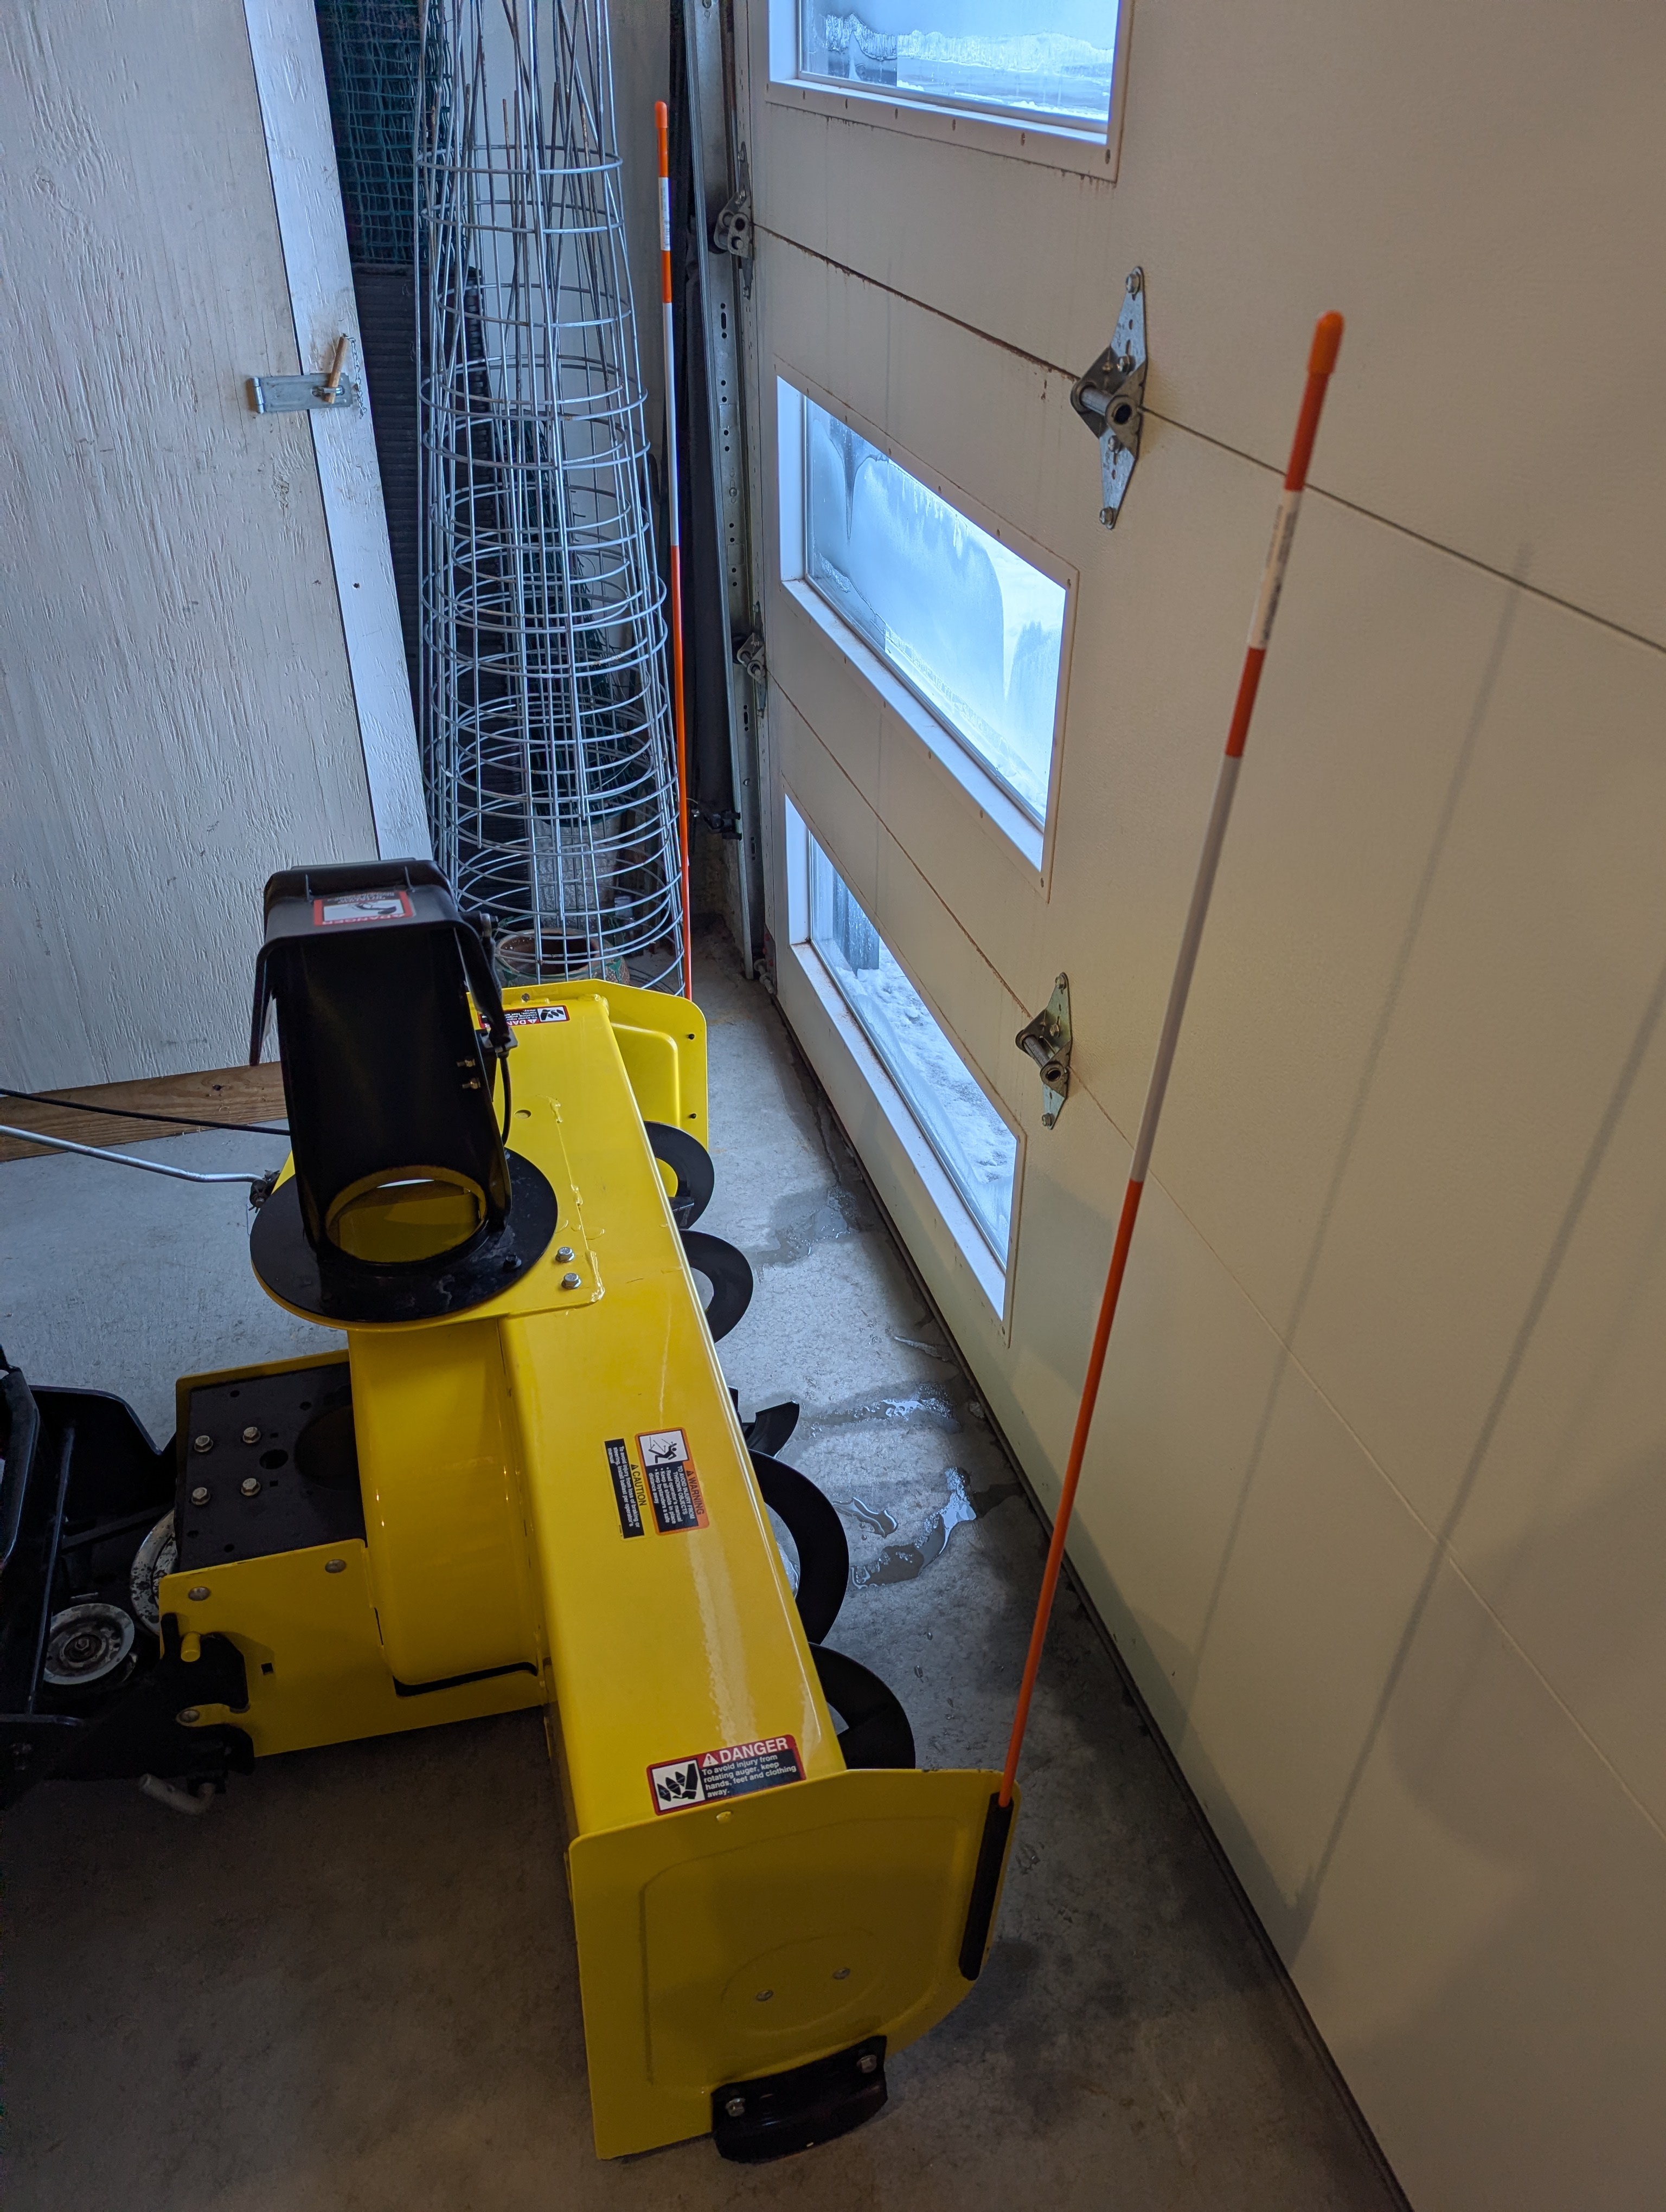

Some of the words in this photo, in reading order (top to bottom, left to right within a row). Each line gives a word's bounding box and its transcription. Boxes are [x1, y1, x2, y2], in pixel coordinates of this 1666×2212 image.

[607, 1448, 616, 1464] manual
[632, 1471, 647, 1506] CAUTION
[648, 1472, 656, 1492] distance
[678, 1472, 687, 1487] AVOID
[656, 1483, 667, 1509] bystanders
[672, 1471, 682, 1492] THROWN
[677, 1492, 688, 1515] OBJECTS
[682, 1487, 691, 1504] INJURY
[688, 1476, 704, 1515] WARNING
[631, 1503, 639, 1522] braking
[664, 1489, 672, 1506] shields
[668, 1511, 676, 1524] place
[674, 1504, 683, 1522] manual
[687, 1504, 695, 1519] FROM
[719, 1737, 789, 1763] DANGER
[703, 1772, 734, 1783] rotating
[760, 1762, 779, 1770] keep
[714, 1763, 735, 1773] avoid
[736, 1759, 758, 1768] injury
[759, 1754, 778, 1763] from
[733, 1776, 748, 1784] feet
[749, 1771, 764, 1780] and
[765, 1765, 797, 1777] clothing
[707, 1788, 730, 1798] away.
